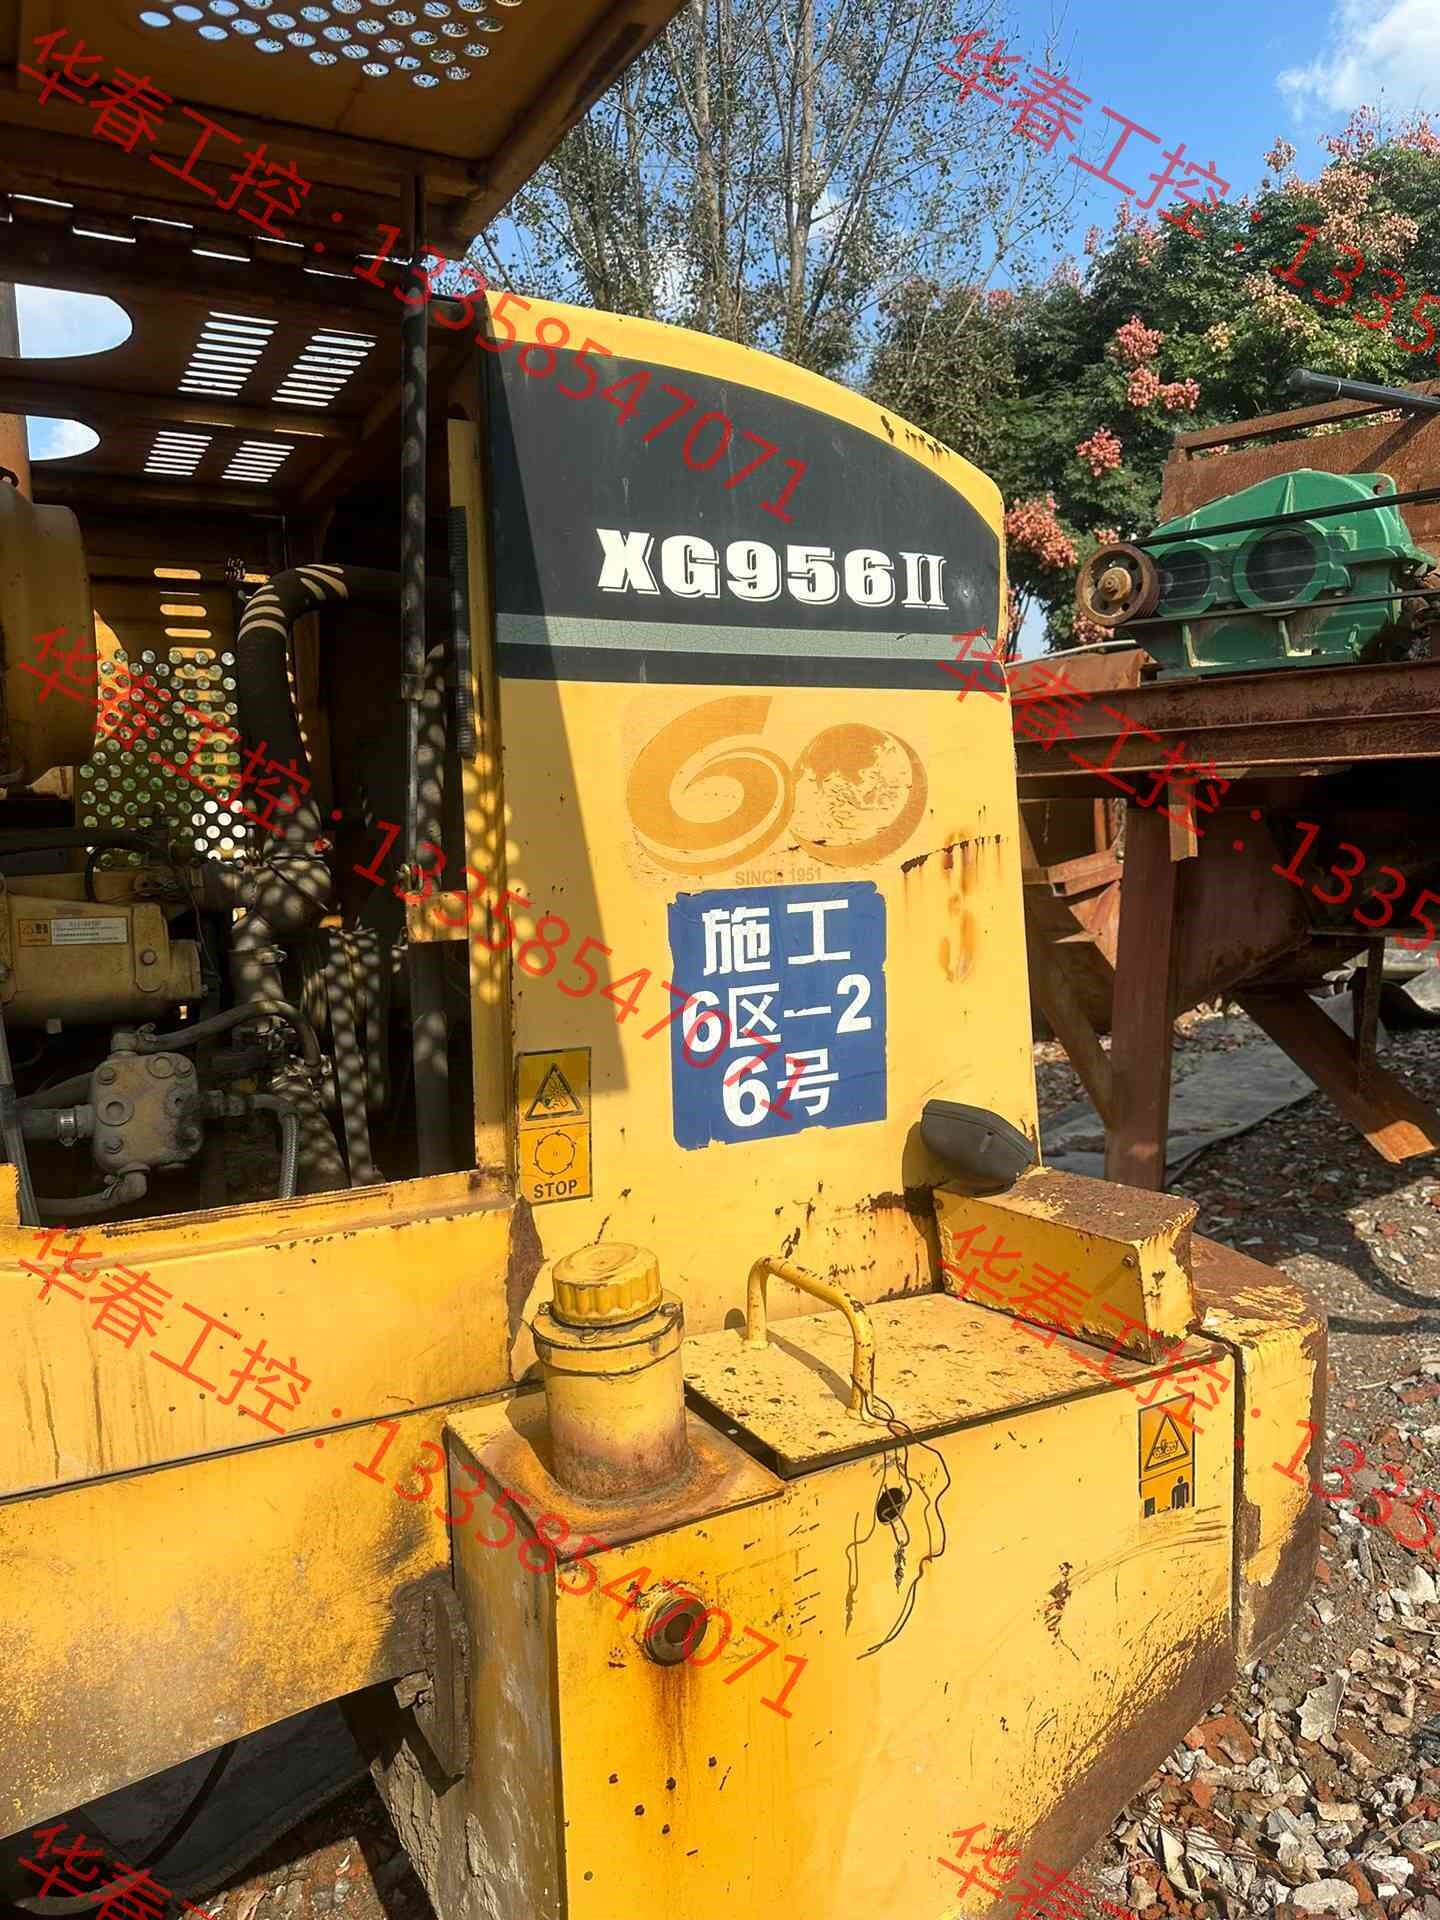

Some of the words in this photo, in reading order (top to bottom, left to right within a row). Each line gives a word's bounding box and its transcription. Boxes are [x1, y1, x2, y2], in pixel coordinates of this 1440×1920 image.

[791, 866, 823, 882] 1951
[702, 899, 851, 977] 施工
[722, 1047, 839, 1127] 6号
[534, 1180, 578, 1199] STOP
